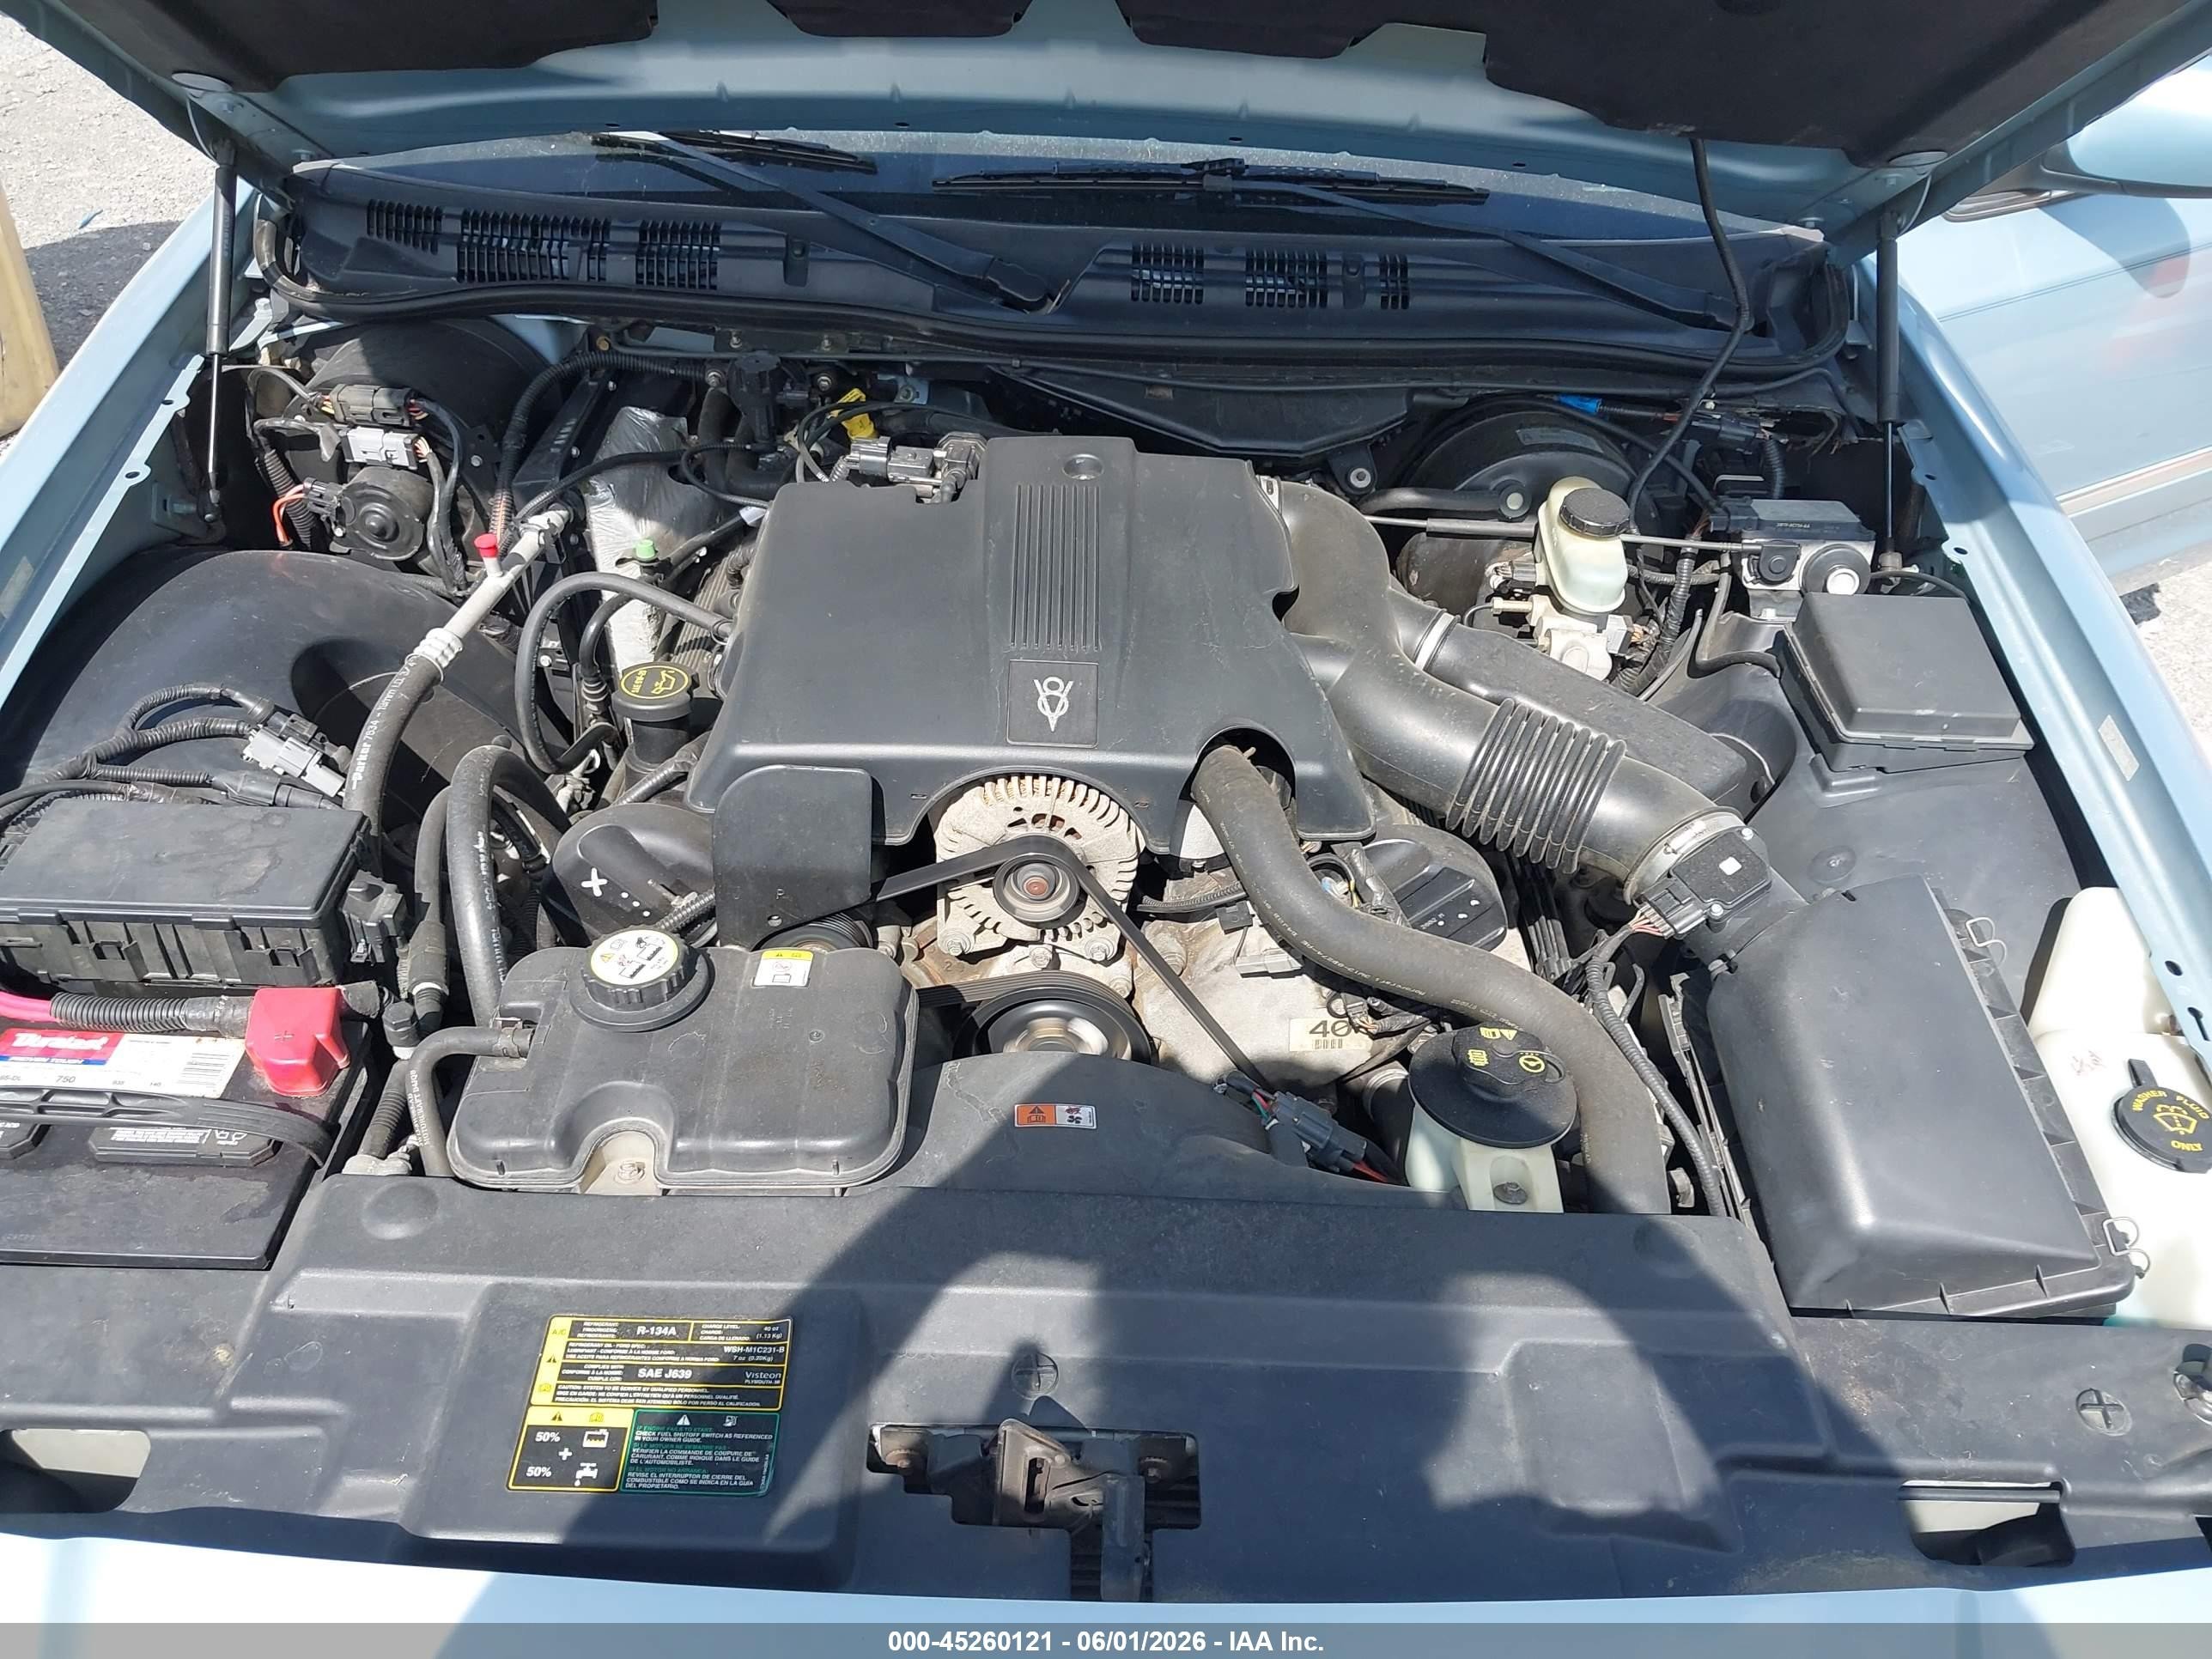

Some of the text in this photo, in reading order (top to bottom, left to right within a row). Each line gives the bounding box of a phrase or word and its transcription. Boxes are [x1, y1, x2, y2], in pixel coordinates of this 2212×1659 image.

[352, 742, 371, 791] Parker
[1309, 1020, 1352, 1037] 40
[2132, 1090, 2210, 1120] WASHER FLUID
[2171, 1139, 2203, 1152] ONLY
[636, 1326, 678, 1336] R-134A
[638, 1368, 692, 1379] SAE J639
[535, 1431, 561, 1443] 50%
[526, 1466, 552, 1478] 50%
